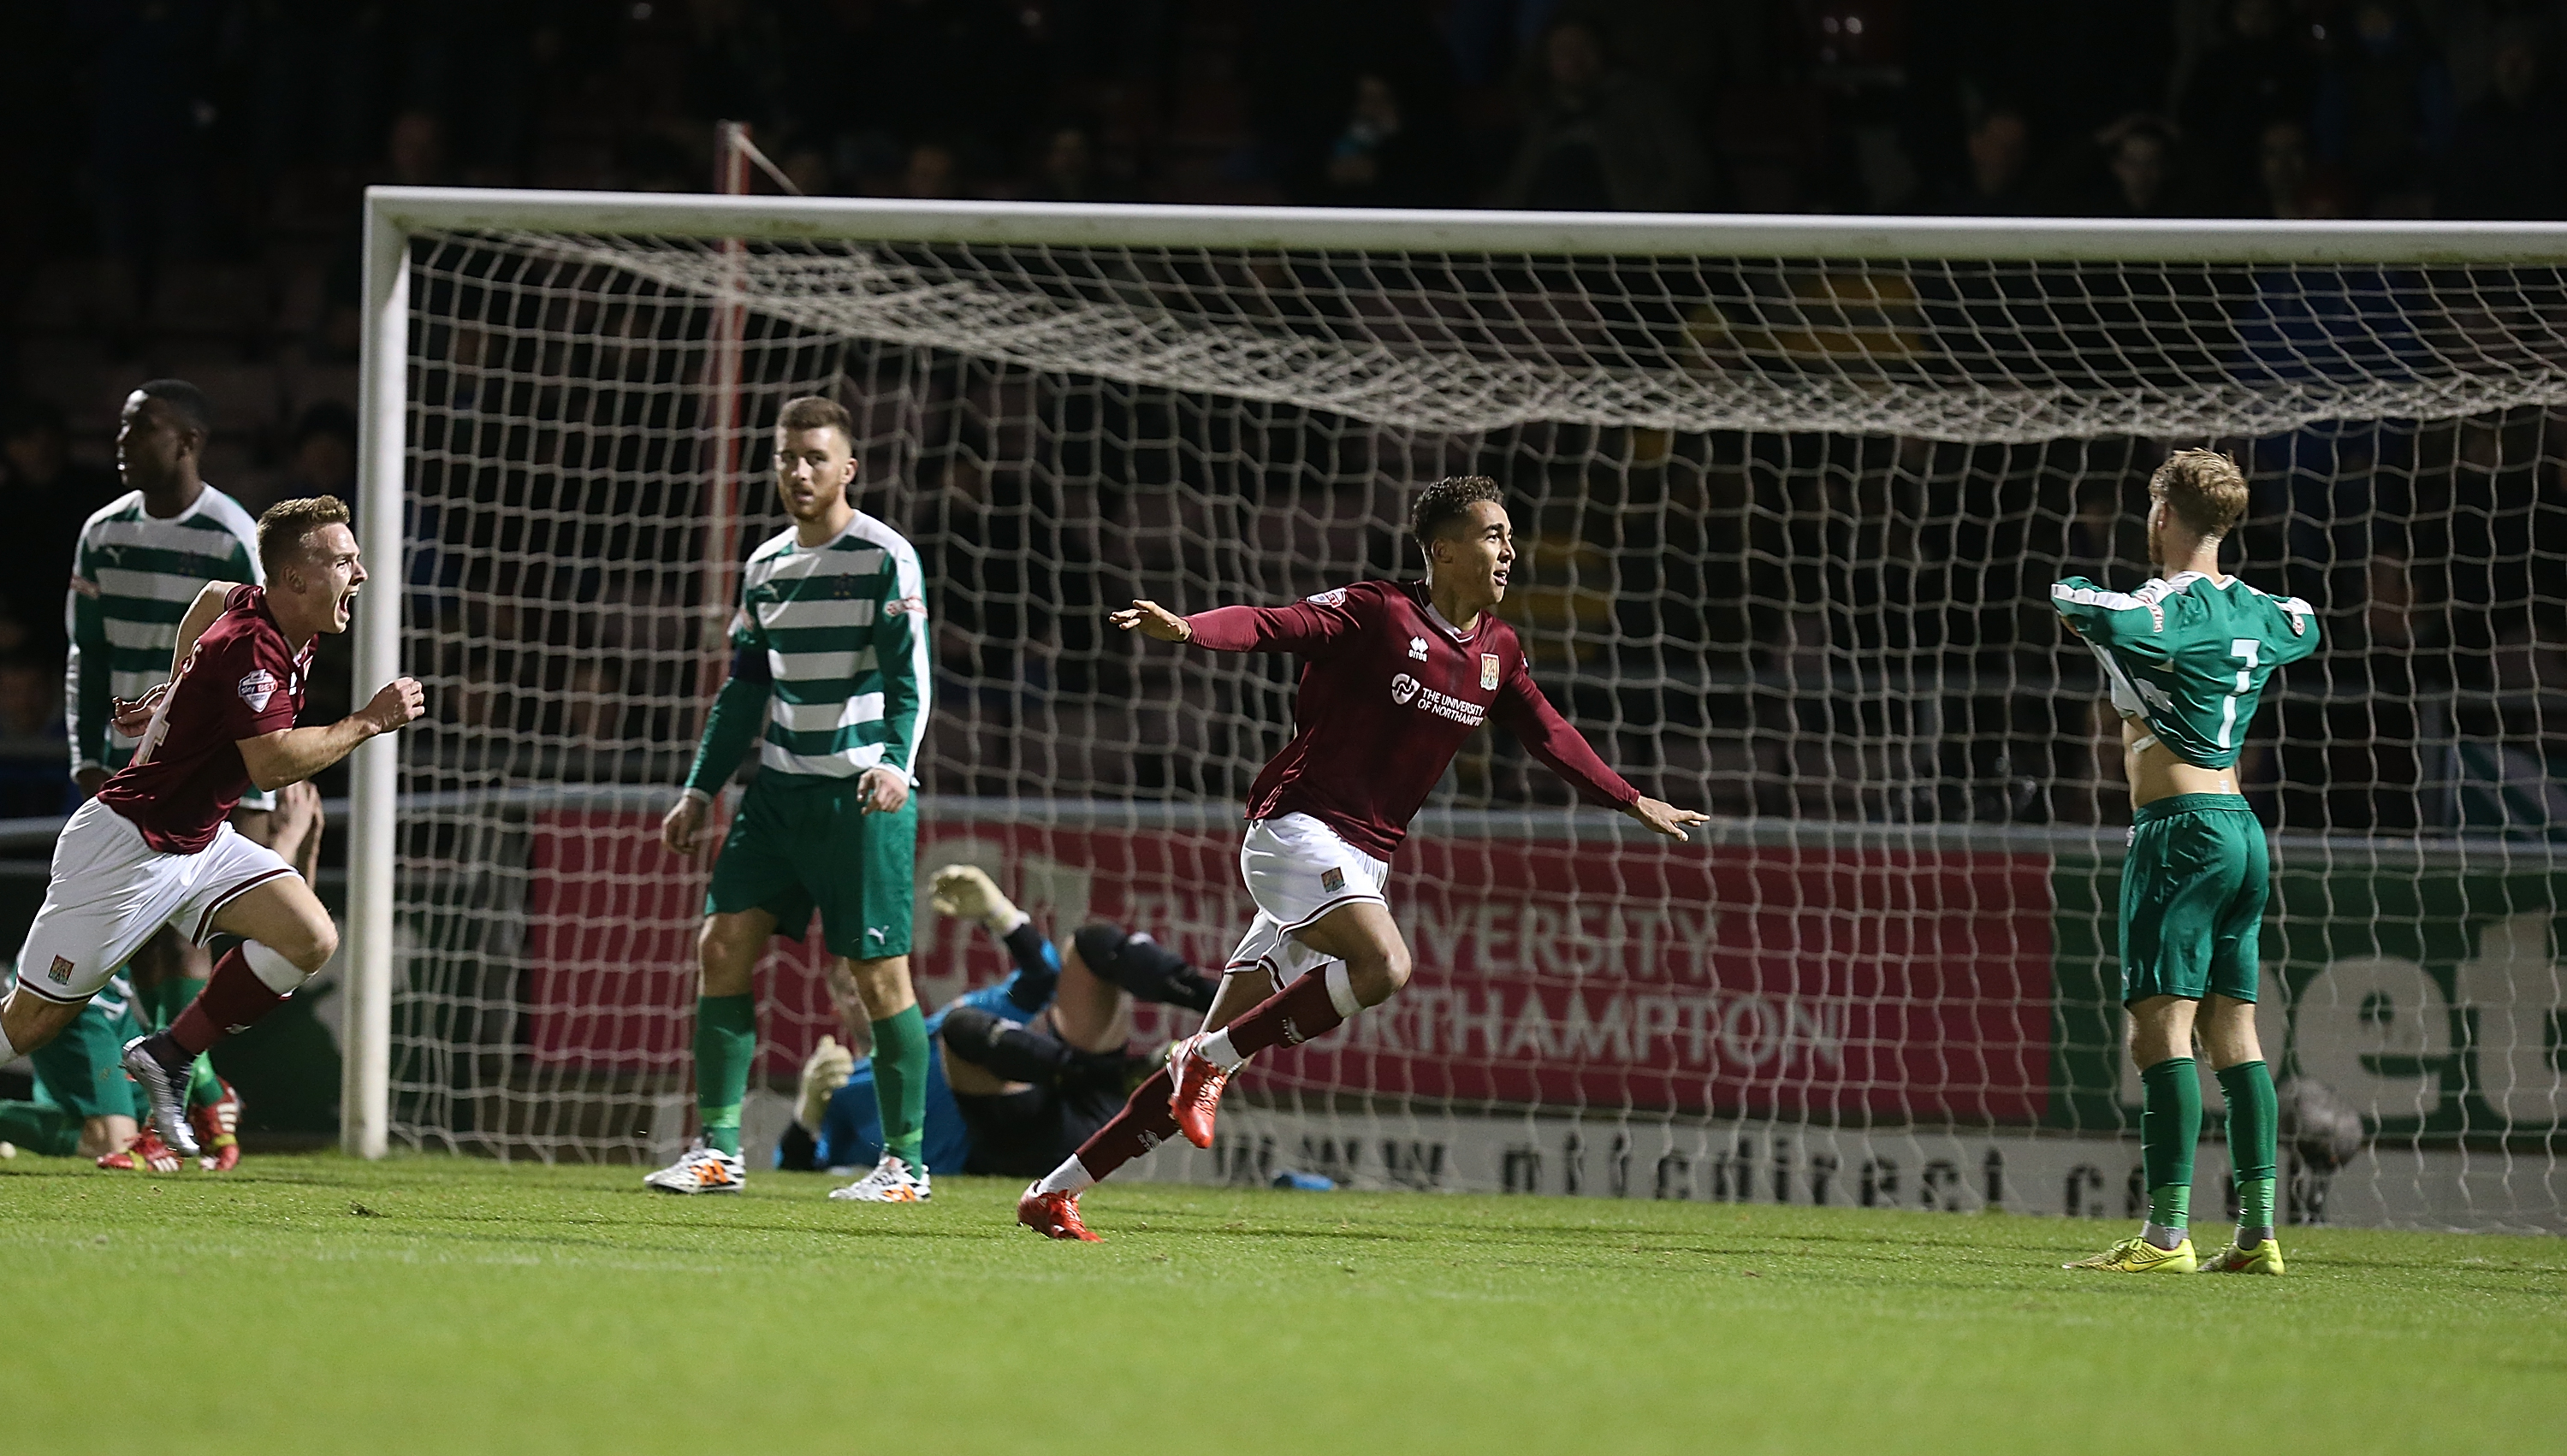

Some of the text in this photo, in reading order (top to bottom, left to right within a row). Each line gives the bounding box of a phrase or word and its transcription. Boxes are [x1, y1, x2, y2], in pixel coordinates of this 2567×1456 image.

[1417, 698, 1432, 711] OF
[1422, 687, 1485, 716] THE UNIVERSITY
[2217, 638, 2261, 749] 7
